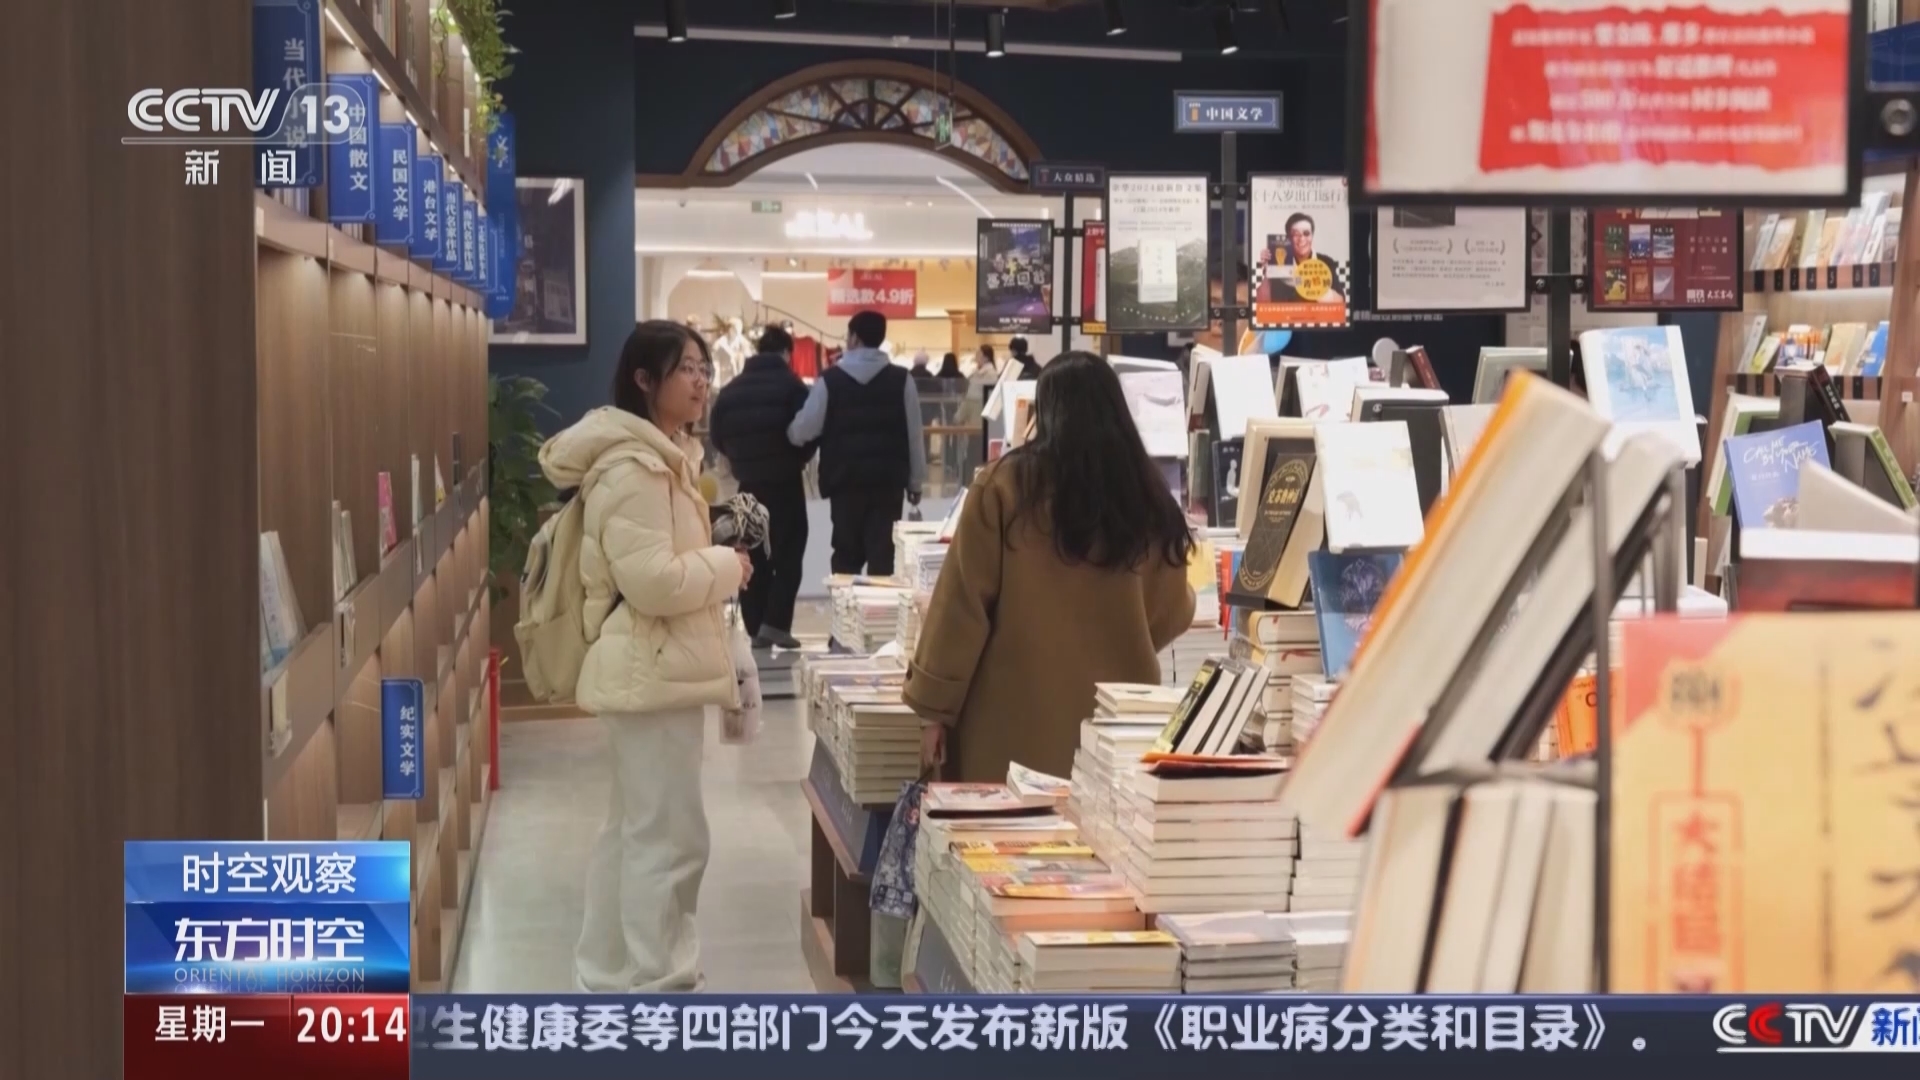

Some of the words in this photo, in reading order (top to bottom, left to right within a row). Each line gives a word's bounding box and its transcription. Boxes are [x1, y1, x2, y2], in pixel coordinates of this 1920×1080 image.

[349, 103, 369, 191] 中国散文
[1206, 106, 1263, 121] 中国文学
[393, 149, 408, 221] 民国文学
[423, 179, 438, 241] 港台文学
[445, 192, 458, 262] 当代名家作品
[400, 706, 415, 777] 纪实文学
